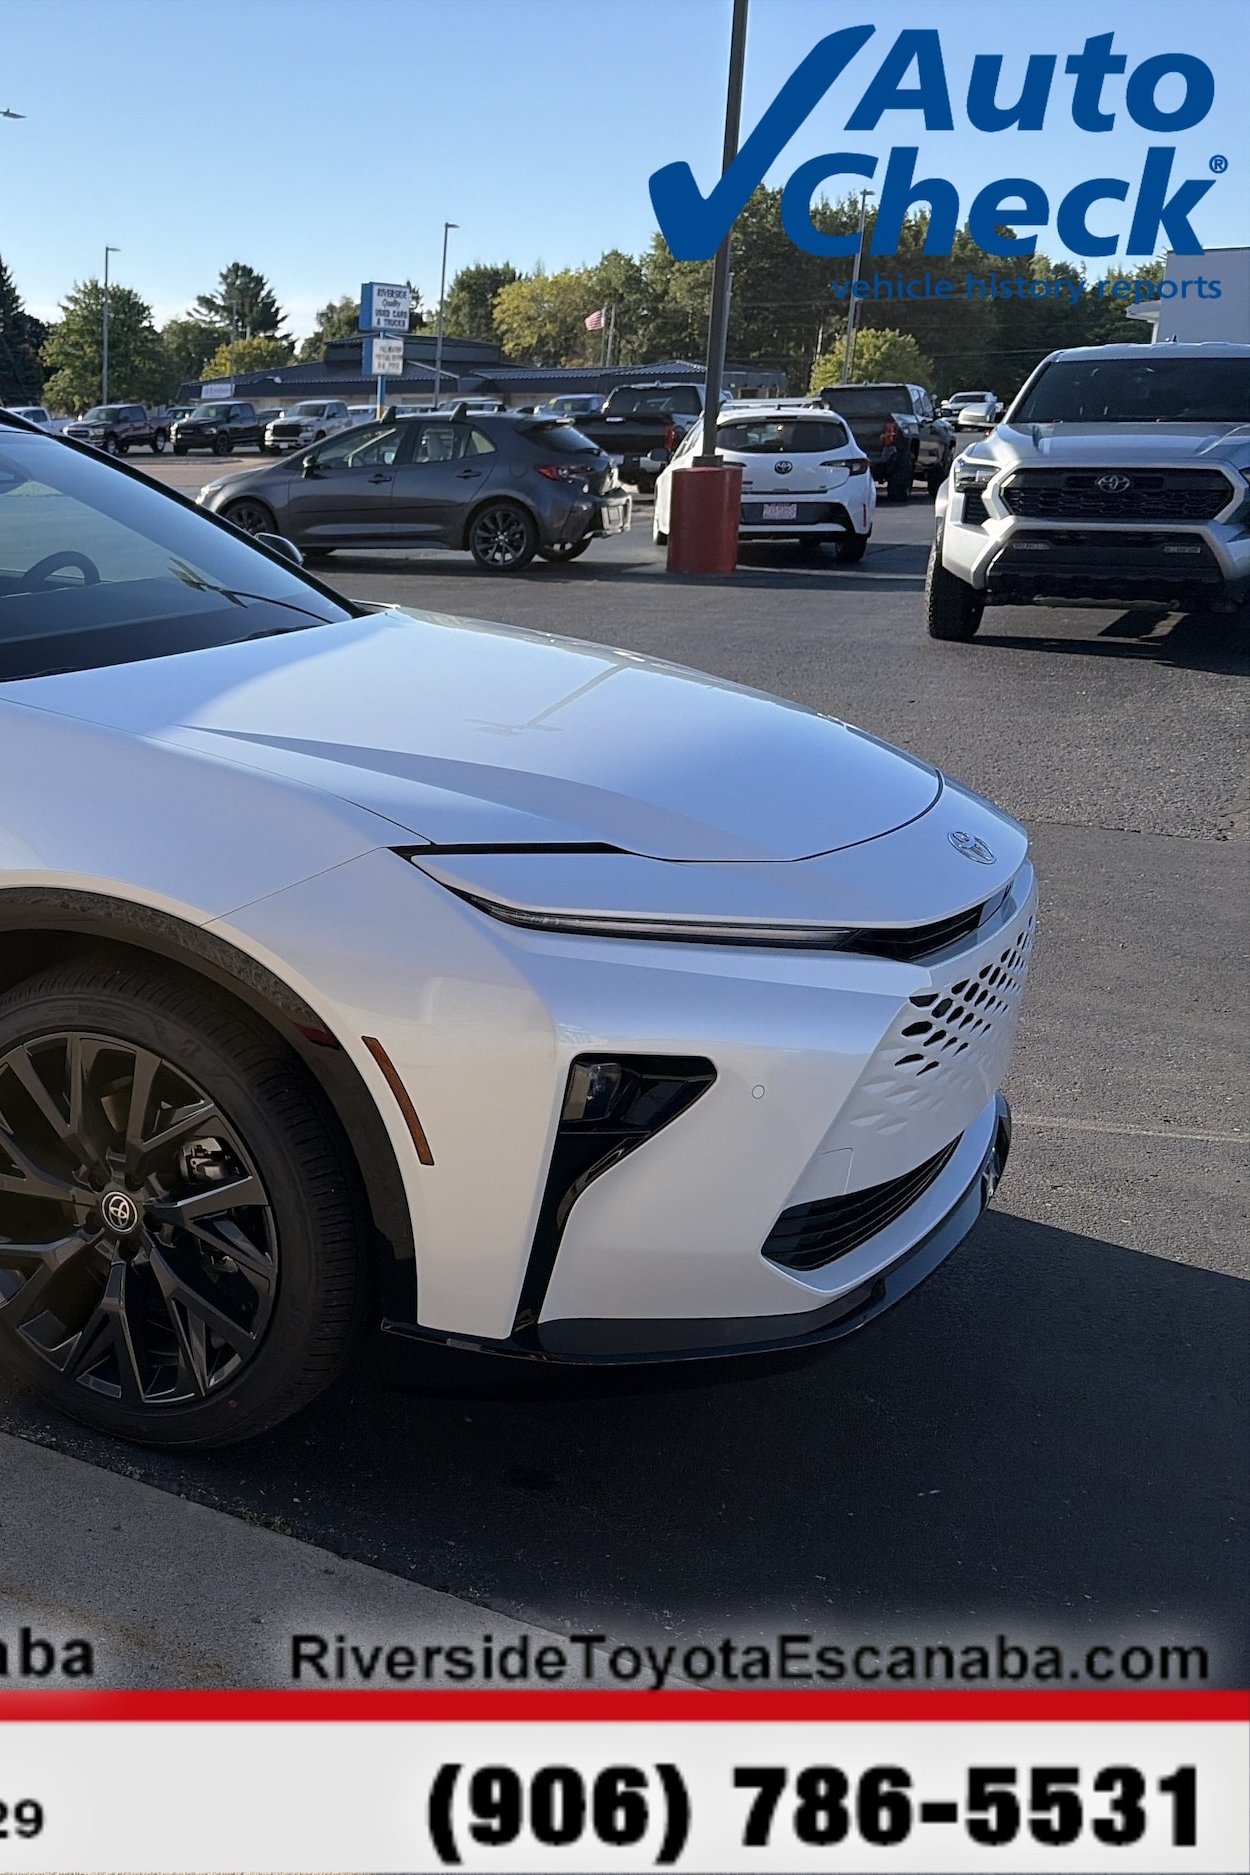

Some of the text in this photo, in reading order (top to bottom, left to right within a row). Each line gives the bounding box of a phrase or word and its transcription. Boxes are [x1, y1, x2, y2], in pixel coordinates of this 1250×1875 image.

[377, 288, 408, 299] RIVERSIDE
[375, 308, 408, 319] USED CARS
[384, 319, 406, 328] TRUCKS
